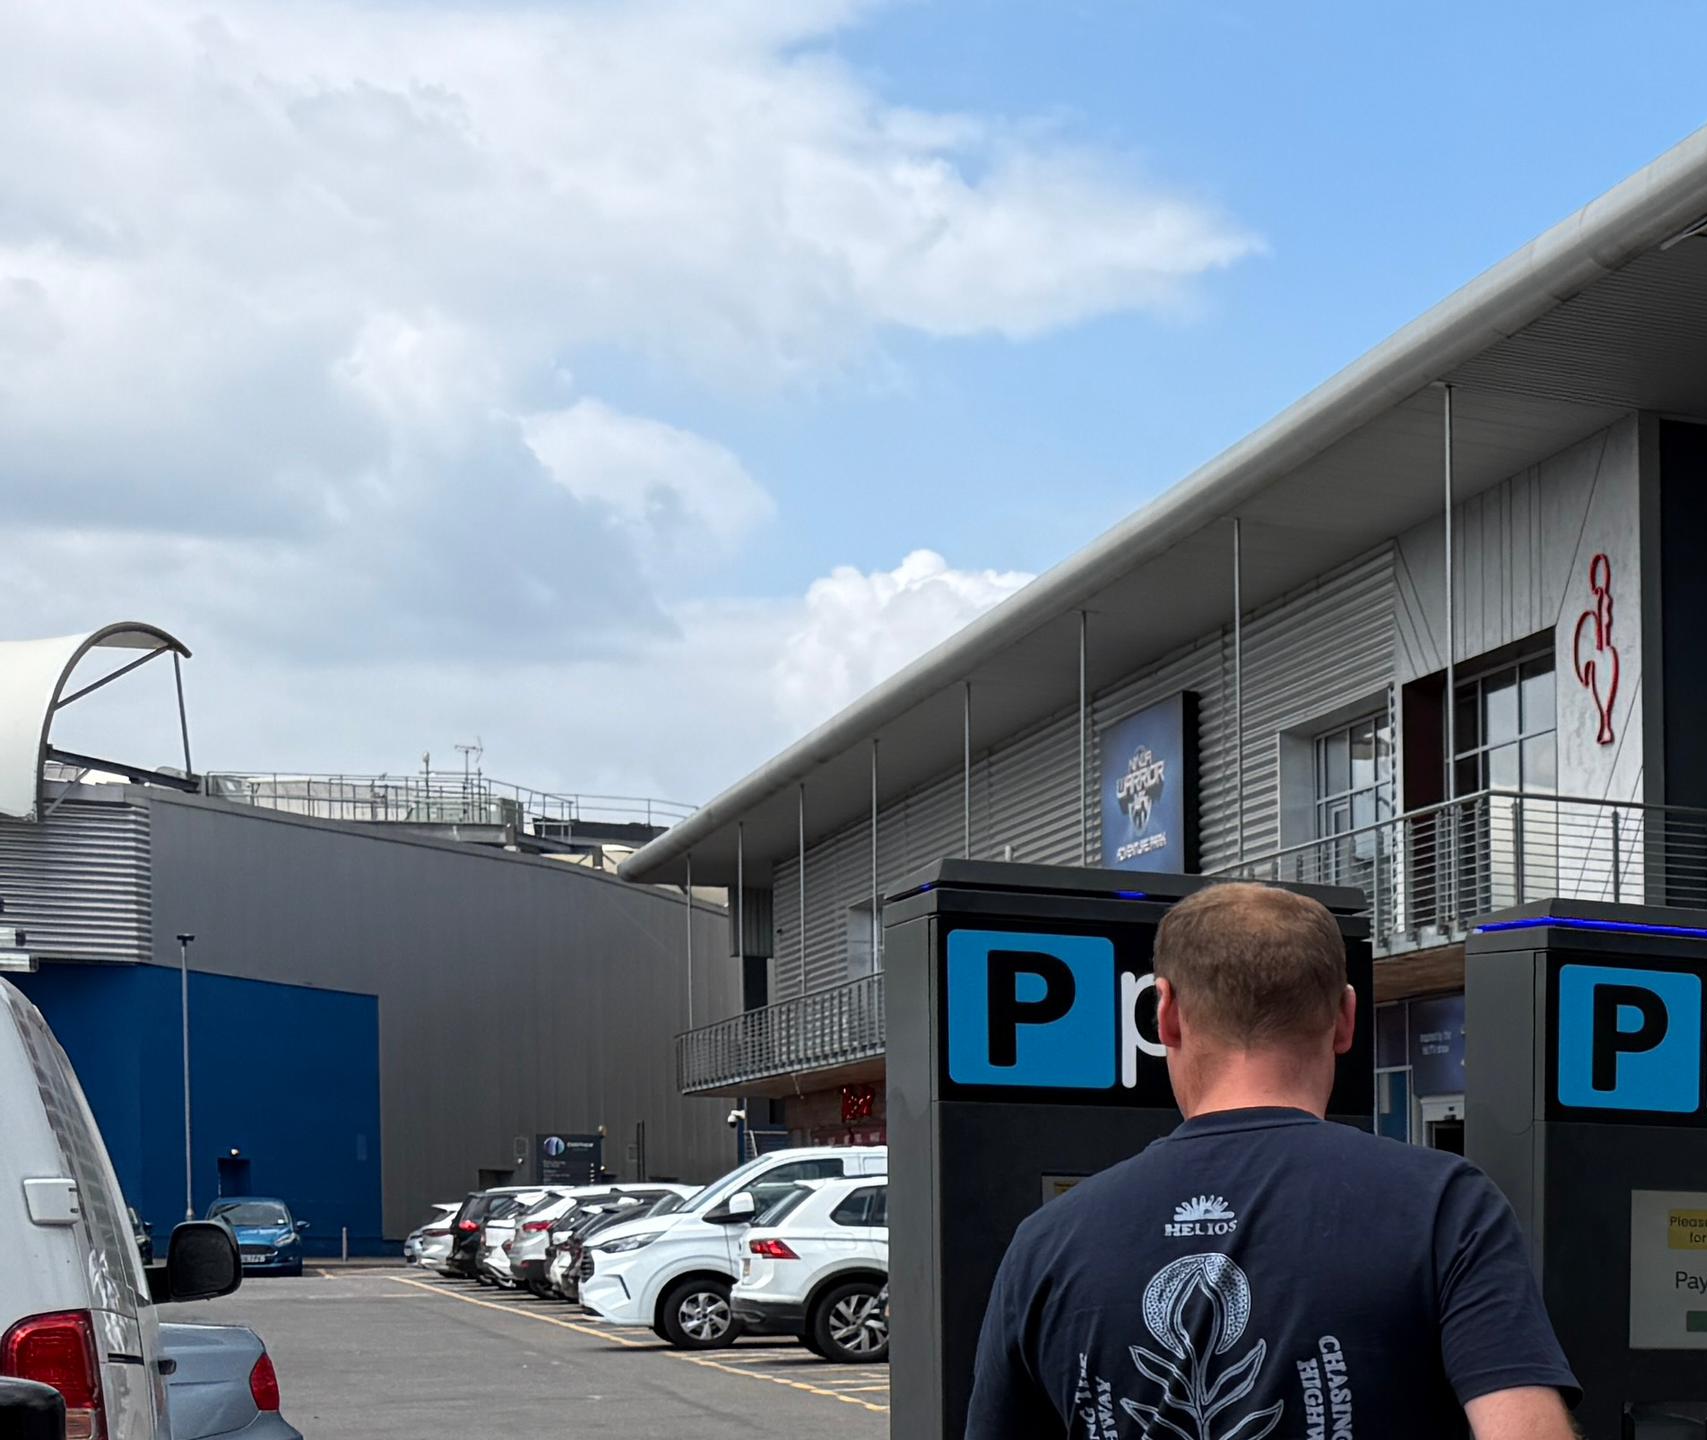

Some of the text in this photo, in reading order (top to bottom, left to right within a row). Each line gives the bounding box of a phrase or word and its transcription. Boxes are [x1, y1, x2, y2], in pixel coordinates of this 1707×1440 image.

[987, 949, 1076, 1068] P
[1592, 982, 1670, 1093] P
[1164, 1219, 1238, 1237] HELIOS
[1689, 1232, 1706, 1244] for
